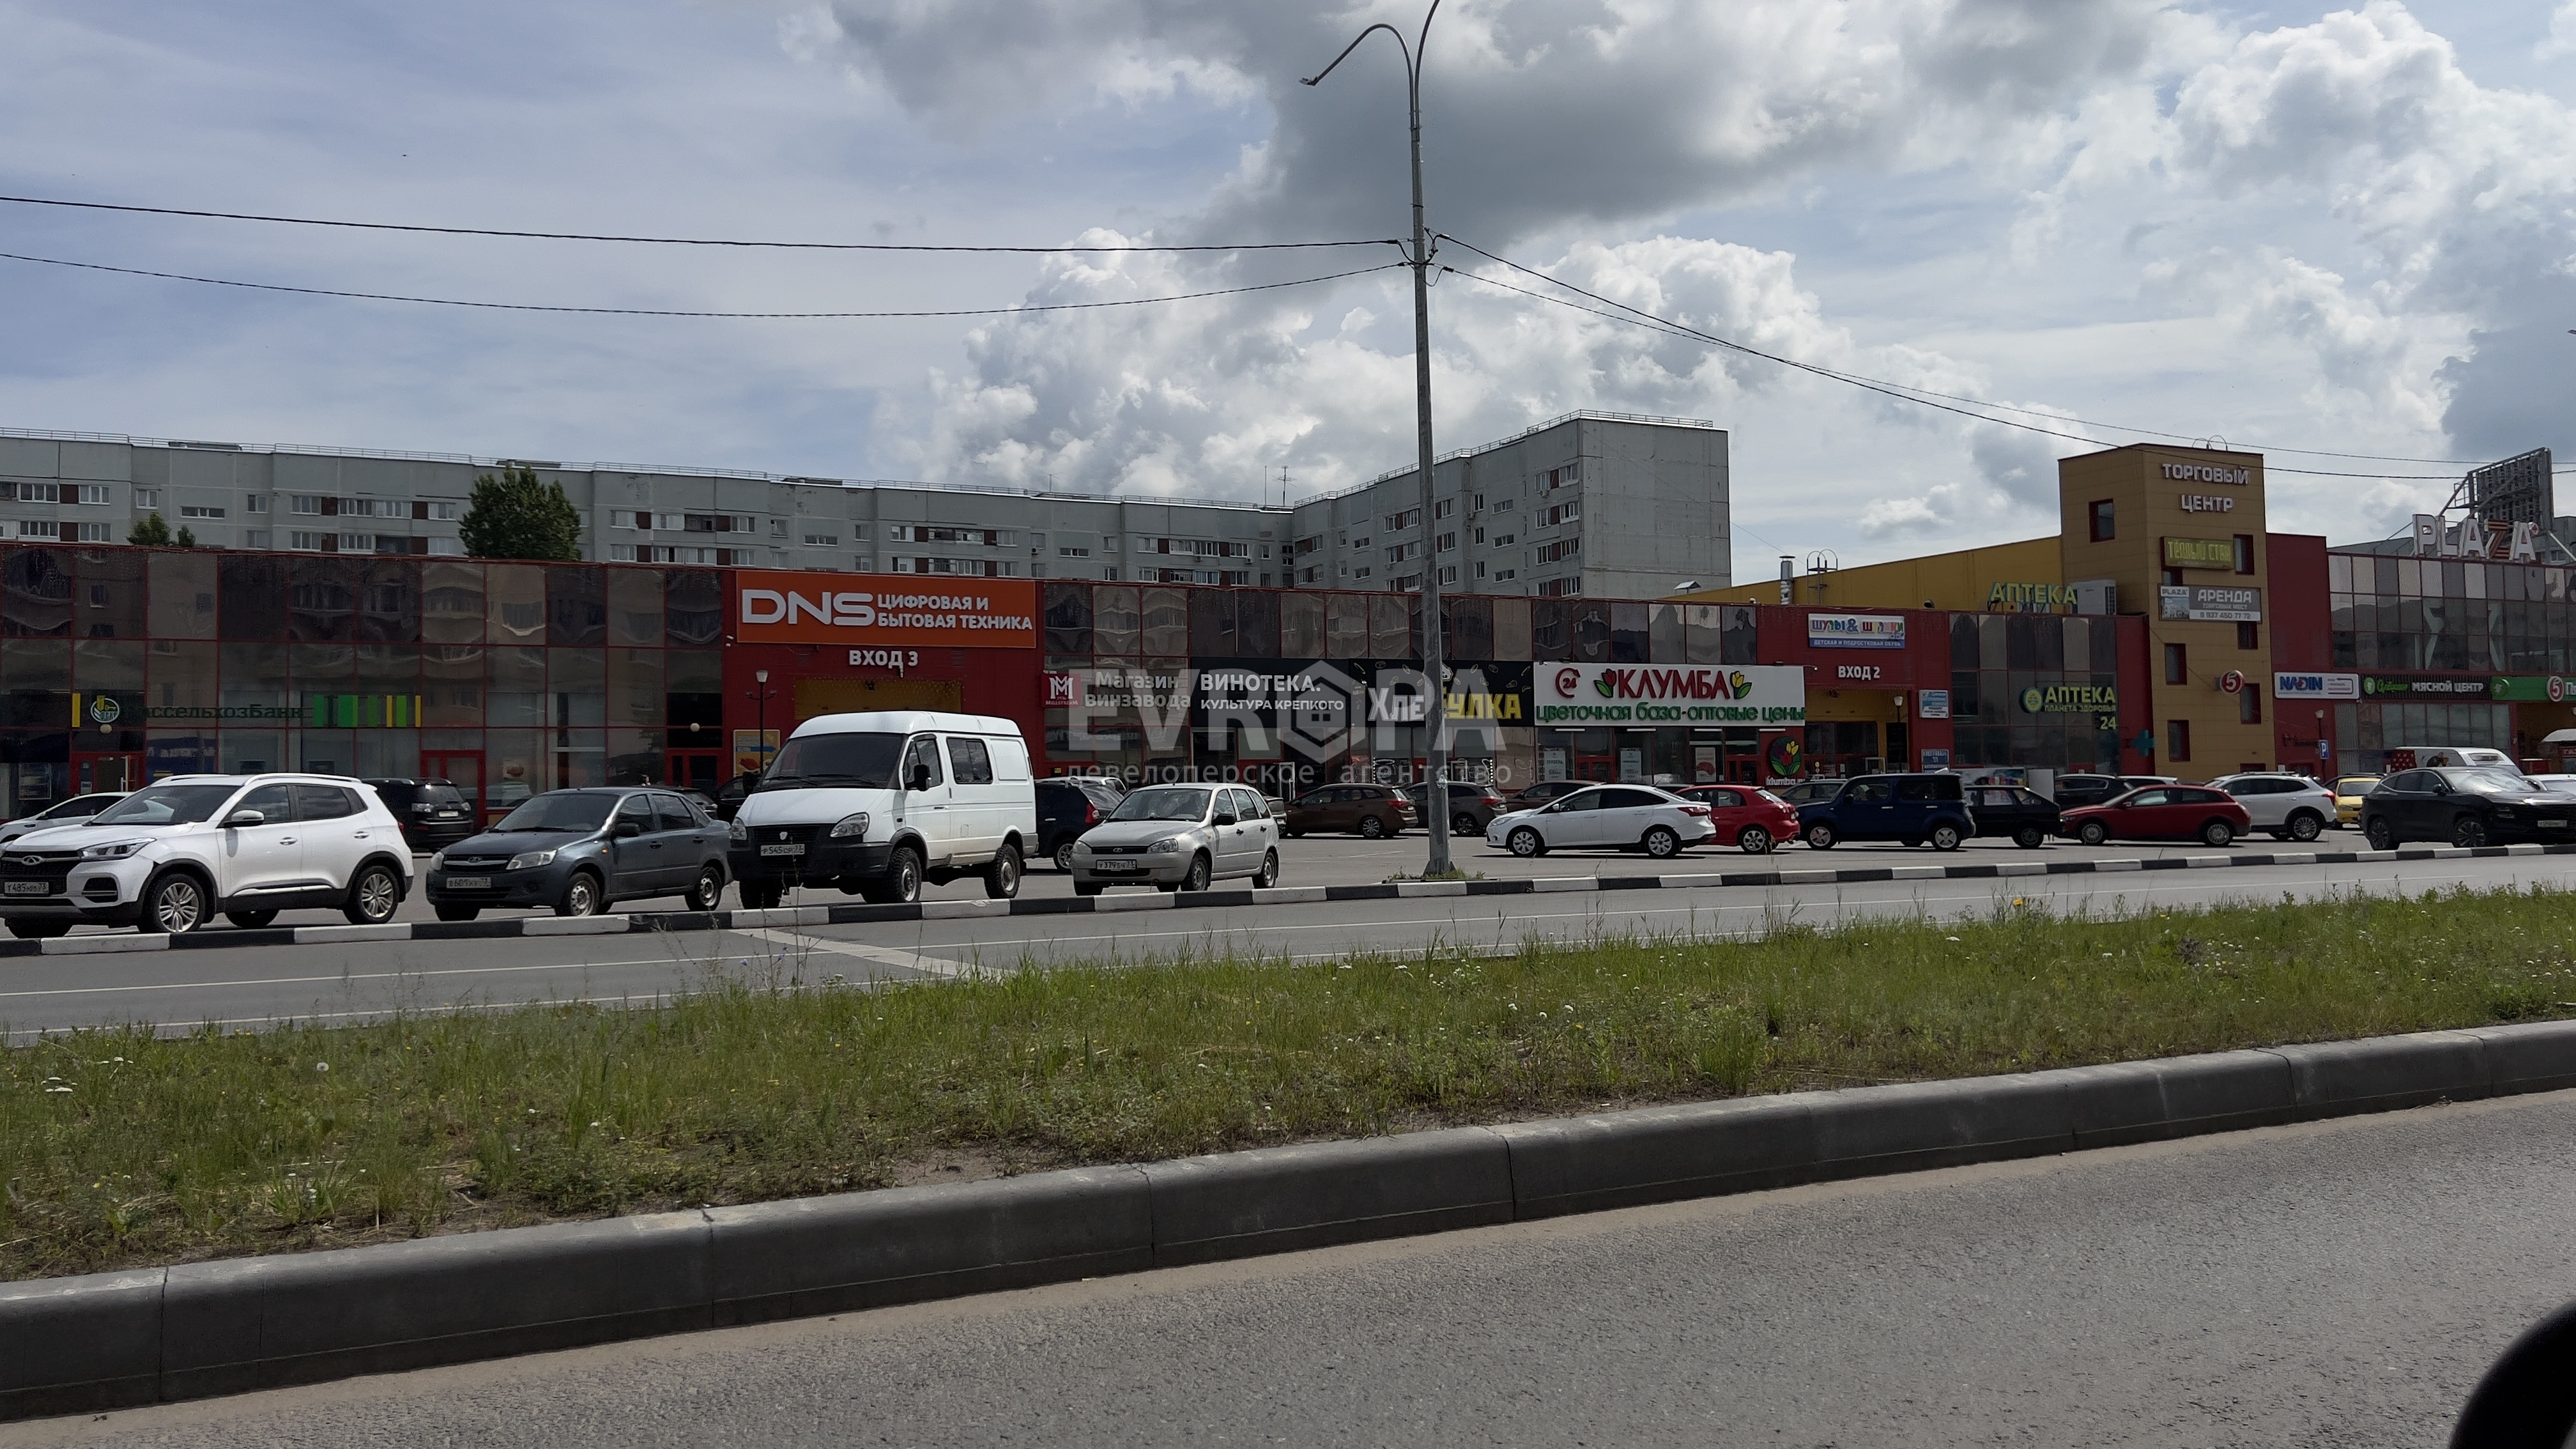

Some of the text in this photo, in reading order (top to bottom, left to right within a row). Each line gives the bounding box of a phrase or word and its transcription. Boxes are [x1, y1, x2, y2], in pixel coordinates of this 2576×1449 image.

[2162, 463, 2250, 484] ТОРГОВЫЙ
[2181, 494, 2234, 513] ЦЕНТР
[2412, 514, 2536, 561] PLAZA
[1989, 582, 2077, 604] АПТЕКА
[2197, 589, 2252, 603] АРЕНДА
[742, 588, 876, 627] DNS
[877, 594, 988, 611] ЦИФРОВАЯ И
[877, 613, 1033, 631] БЫТОВАЯ ТЕХНИКА
[848, 649, 919, 669] ВХОД 3
[1095, 671, 1179, 689] Магазин
[1837, 665, 1881, 680] ВХОД 2
[1200, 673, 1321, 692] ВИНОТЕКА.
[1563, 677, 1577, 689] 24
[1618, 669, 1731, 699] КЛУМБА
[2411, 680, 2453, 692] МЯСНОЙ
[2454, 682, 2484, 693] ЦЕНТР
[1084, 694, 1191, 710] винзавода
[2044, 686, 2117, 703] АПТЕКА
[1200, 699, 1344, 710] КУЛЬТУРА КРЕПКОГО
[2080, 705, 2117, 713] ЗДОРОВЬЯ
[1536, 705, 1631, 723] цветочная
[1761, 705, 1806, 723] цены
[2100, 716, 2117, 730] 24
